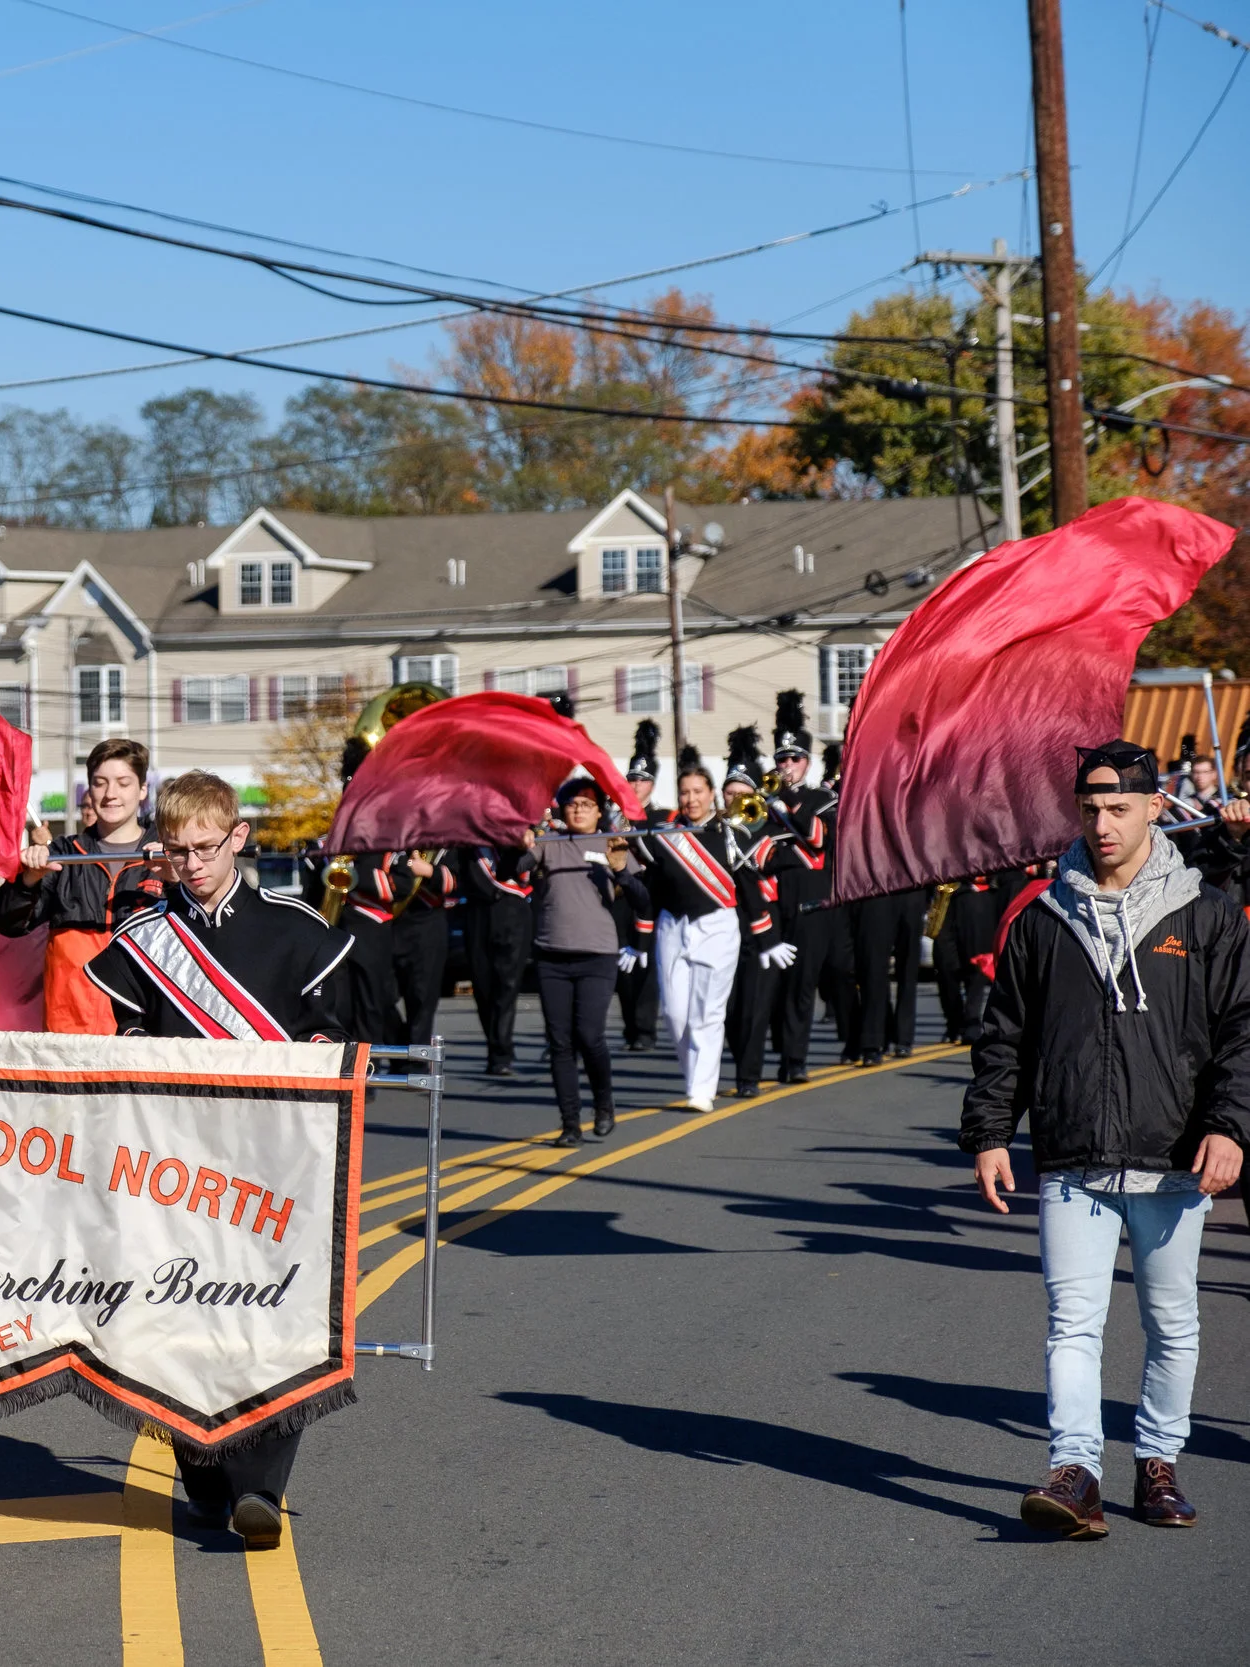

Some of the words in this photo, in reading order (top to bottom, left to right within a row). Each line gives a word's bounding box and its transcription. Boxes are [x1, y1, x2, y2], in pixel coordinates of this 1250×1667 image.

[223, 903, 235, 918] N
[109, 1145, 295, 1242] NORTH
[146, 1257, 301, 1308] Band
